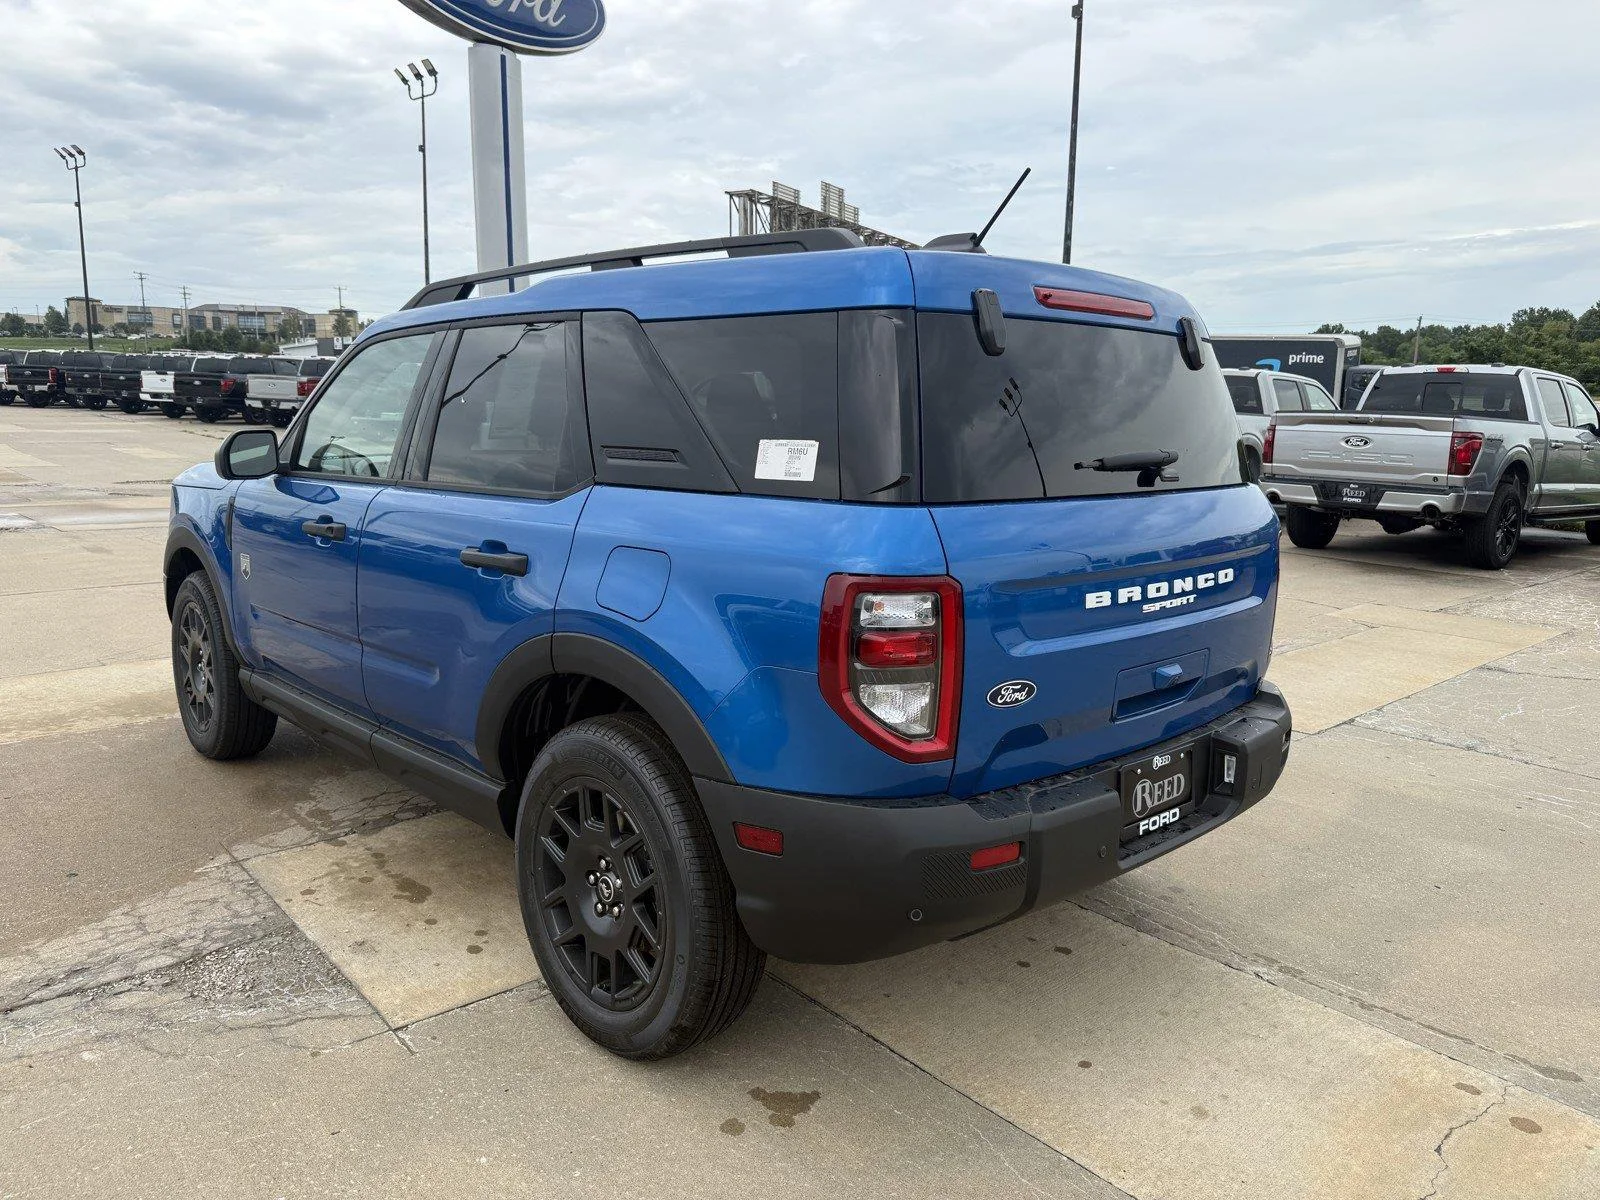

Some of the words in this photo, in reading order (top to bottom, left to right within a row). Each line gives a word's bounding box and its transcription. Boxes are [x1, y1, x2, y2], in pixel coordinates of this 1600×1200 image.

[1288, 351, 1325, 365] prime
[1341, 487, 1366, 497] REED
[1085, 568, 1234, 610] BRONCO
[1142, 594, 1197, 613] SPORT
[997, 684, 1029, 704] Ford
[1132, 773, 1185, 819] REED
[1139, 807, 1180, 835] FORD
